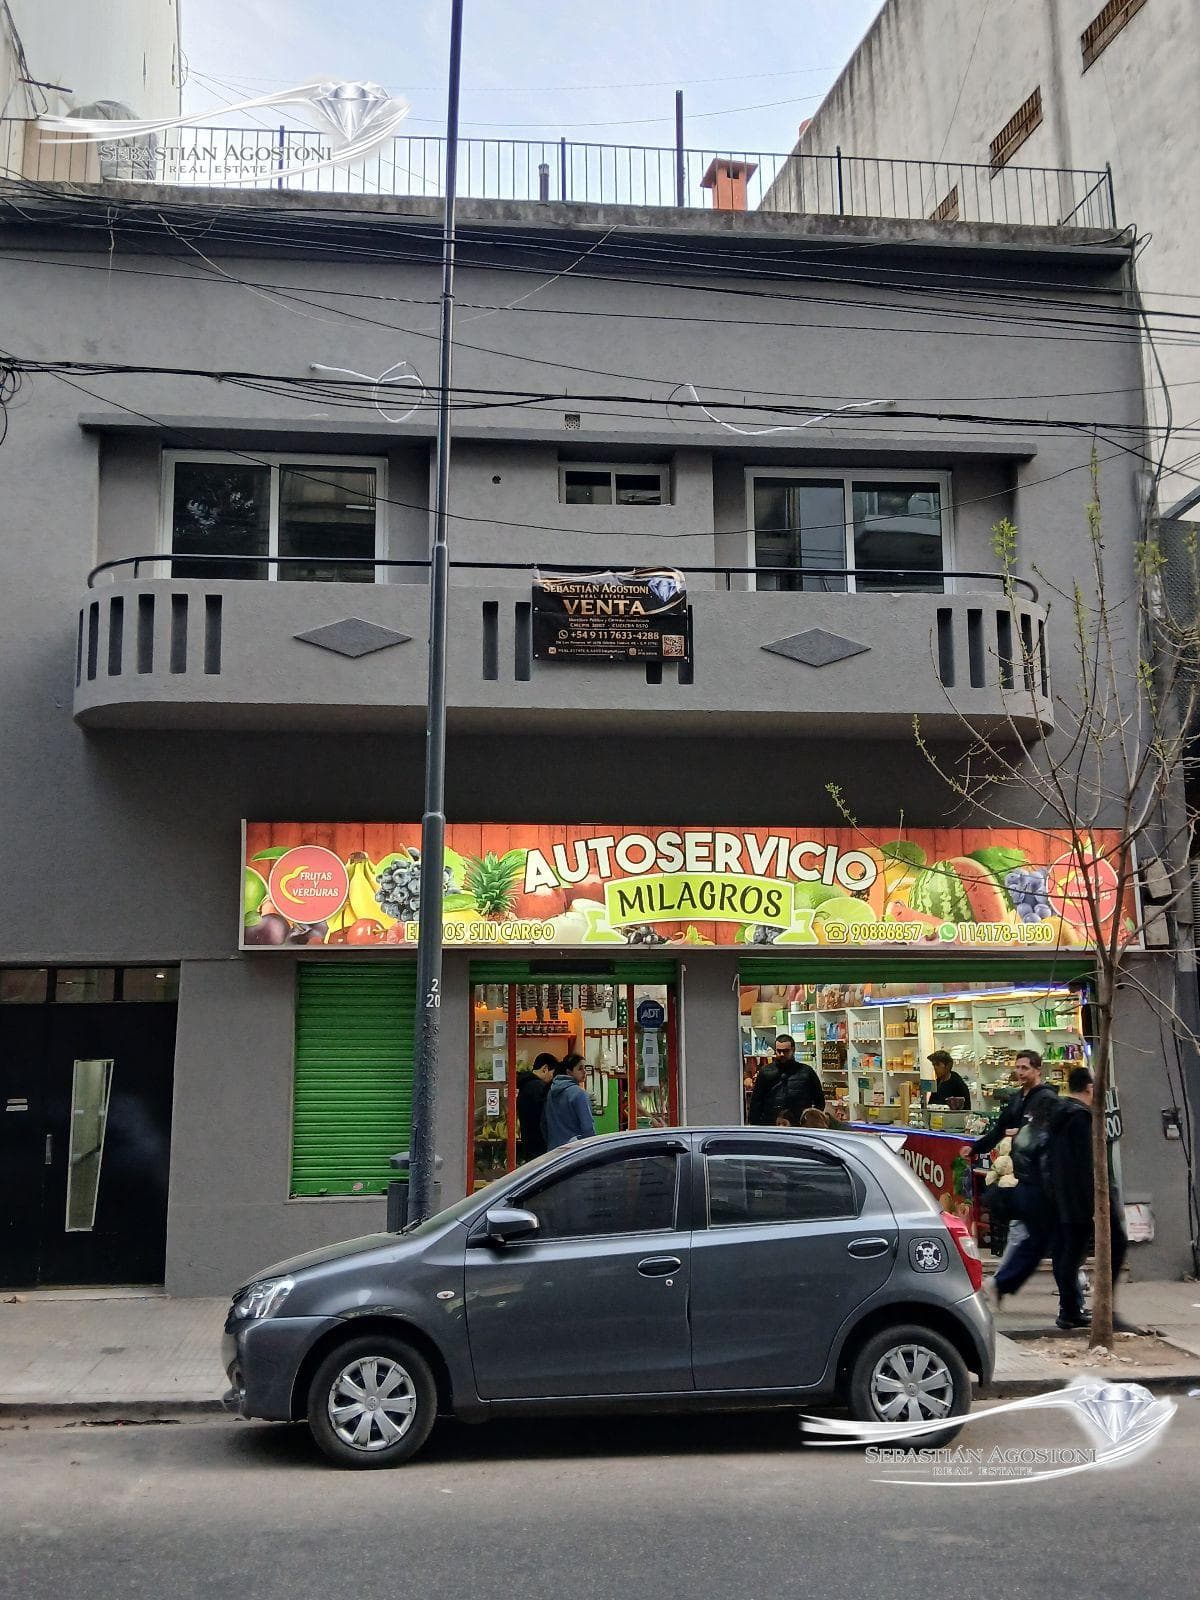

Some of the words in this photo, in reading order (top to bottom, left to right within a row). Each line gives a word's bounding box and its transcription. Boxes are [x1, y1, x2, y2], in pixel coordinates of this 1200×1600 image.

[544, 584, 600, 594] SEBASTIÁN
[602, 584, 650, 594] AGOSTONI
[562, 599, 646, 615] VENTA
[570, 630, 588, 639] +54
[589, 630, 597, 639] 9
[599, 630, 608, 639] 11
[610, 630, 660, 640] 7633-4288
[523, 830, 878, 895] AUTOSERVICIO
[300, 871, 333, 881] FRUTAS
[312, 880, 320, 889] Y
[292, 887, 339, 897] VERDURAS
[617, 880, 783, 918] MILAGROS
[406, 922, 465, 941] EOS
[469, 922, 497, 941] SIN
[501, 922, 555, 941] CARGO
[850, 922, 922, 941] 90886857
[959, 923, 1053, 942] 114178-1580
[431, 978, 439, 992] 2
[425, 993, 441, 1008] 20
[641, 1008, 661, 1019] ADT
